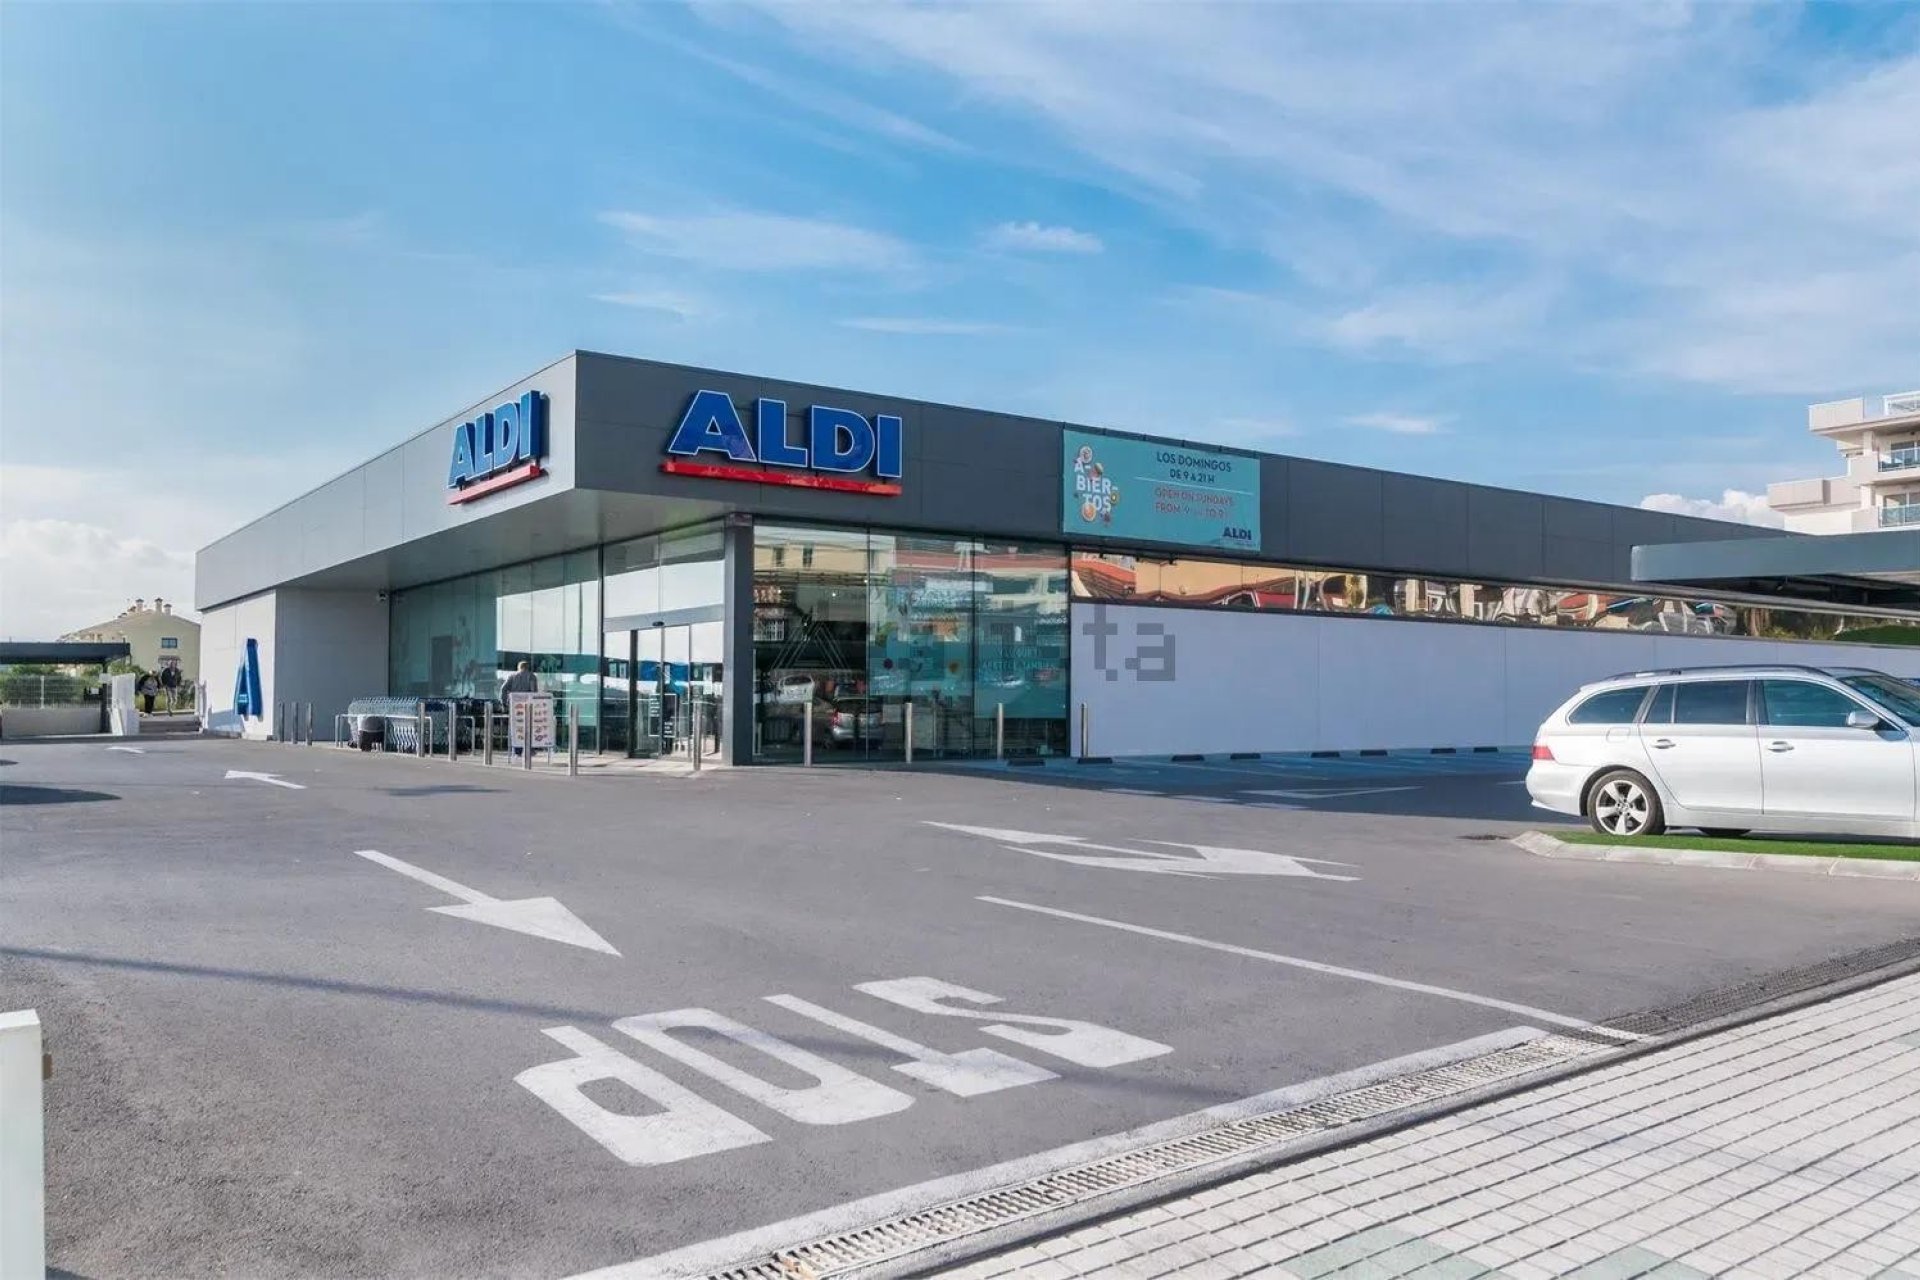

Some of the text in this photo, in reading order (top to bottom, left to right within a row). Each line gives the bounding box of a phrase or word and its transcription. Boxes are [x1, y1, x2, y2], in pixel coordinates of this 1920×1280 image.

[447, 389, 545, 490] ALDI
[667, 388, 903, 479] ALDI
[1156, 452, 1231, 473] LOS DOMINGOS
[1170, 468, 1181, 479] DE
[1183, 471, 1189, 480] 9
[1198, 473, 1206, 482] 21
[1082, 494, 1112, 513] TOS
[1155, 502, 1181, 514] FROM
[1223, 526, 1252, 541] ALDI
[513, 975, 1175, 1167] STOP
